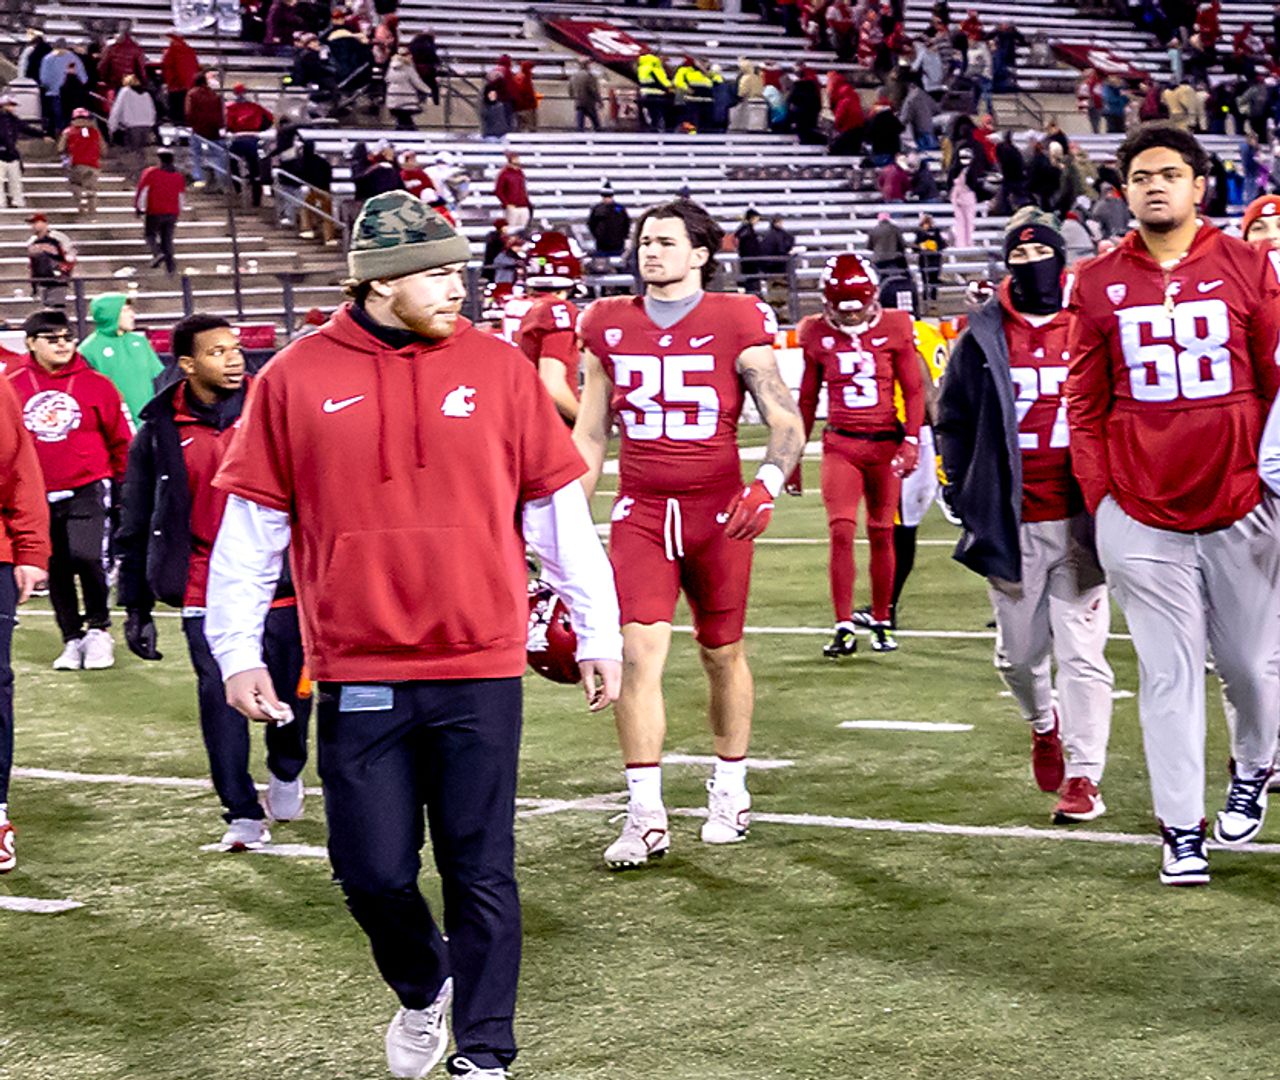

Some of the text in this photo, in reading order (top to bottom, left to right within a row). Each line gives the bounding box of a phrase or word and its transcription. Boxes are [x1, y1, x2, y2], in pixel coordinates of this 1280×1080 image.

[551, 304, 571, 328] 5
[1114, 299, 1233, 402] 68
[608, 353, 719, 440] 35
[836, 351, 879, 408] 3
